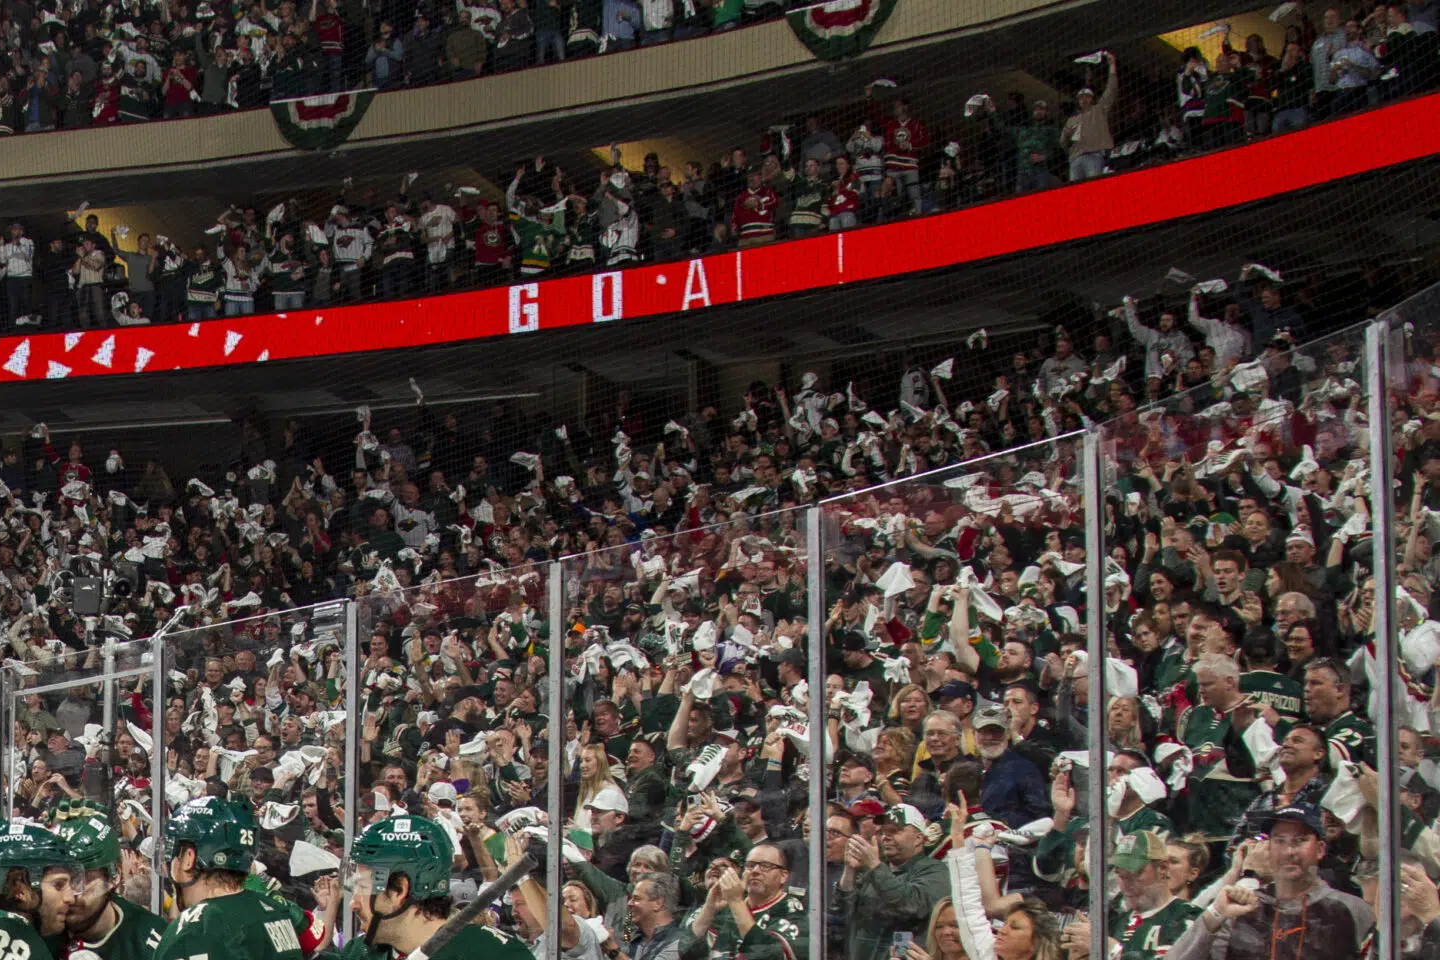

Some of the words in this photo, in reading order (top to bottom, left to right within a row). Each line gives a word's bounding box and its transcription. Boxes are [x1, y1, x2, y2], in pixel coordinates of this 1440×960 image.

[0, 834, 33, 843] TOYOTA
[239, 828, 255, 846] 25
[381, 832, 422, 842] TOYOTA
